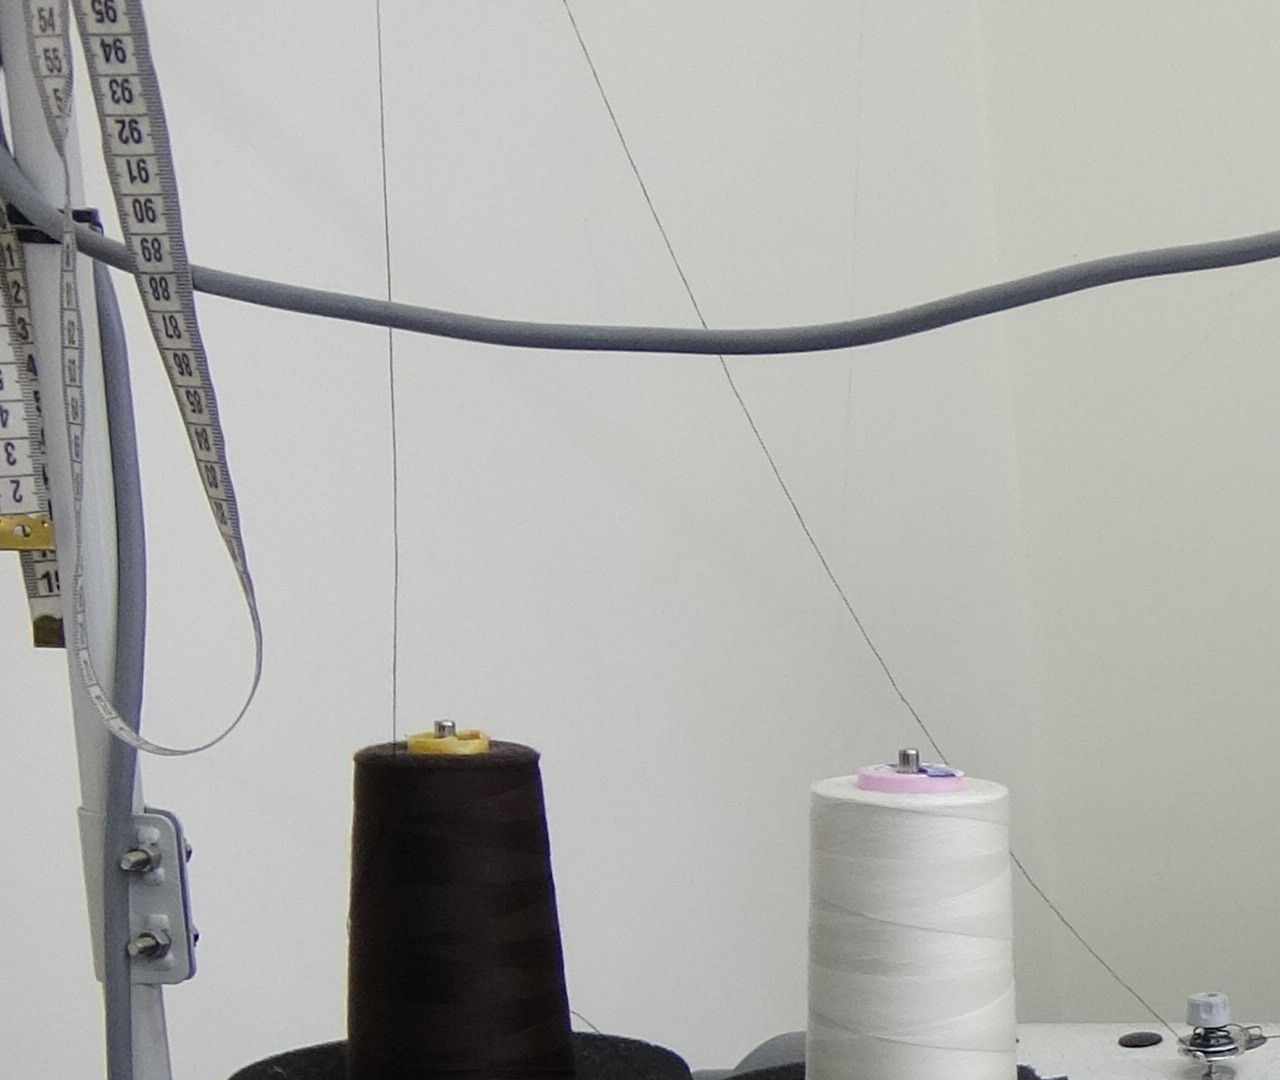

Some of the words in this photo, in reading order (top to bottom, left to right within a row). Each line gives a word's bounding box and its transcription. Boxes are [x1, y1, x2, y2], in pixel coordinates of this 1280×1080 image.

[91, 0, 117, 23] 95
[43, 47, 62, 74] 55
[100, 38, 127, 64] 94
[108, 78, 134, 105] 93
[115, 118, 142, 144] 92
[126, 158, 150, 184] 91
[132, 198, 156, 223] 90
[140, 237, 163, 262] 89
[12, 280, 23, 303] 2
[149, 276, 171, 301] 88
[18, 316, 29, 341] 3
[161, 314, 182, 340] 87
[172, 352, 193, 378] 86
[185, 390, 204, 415] 85
[4, 442, 17, 466] 3
[9, 479, 23, 503] 2
